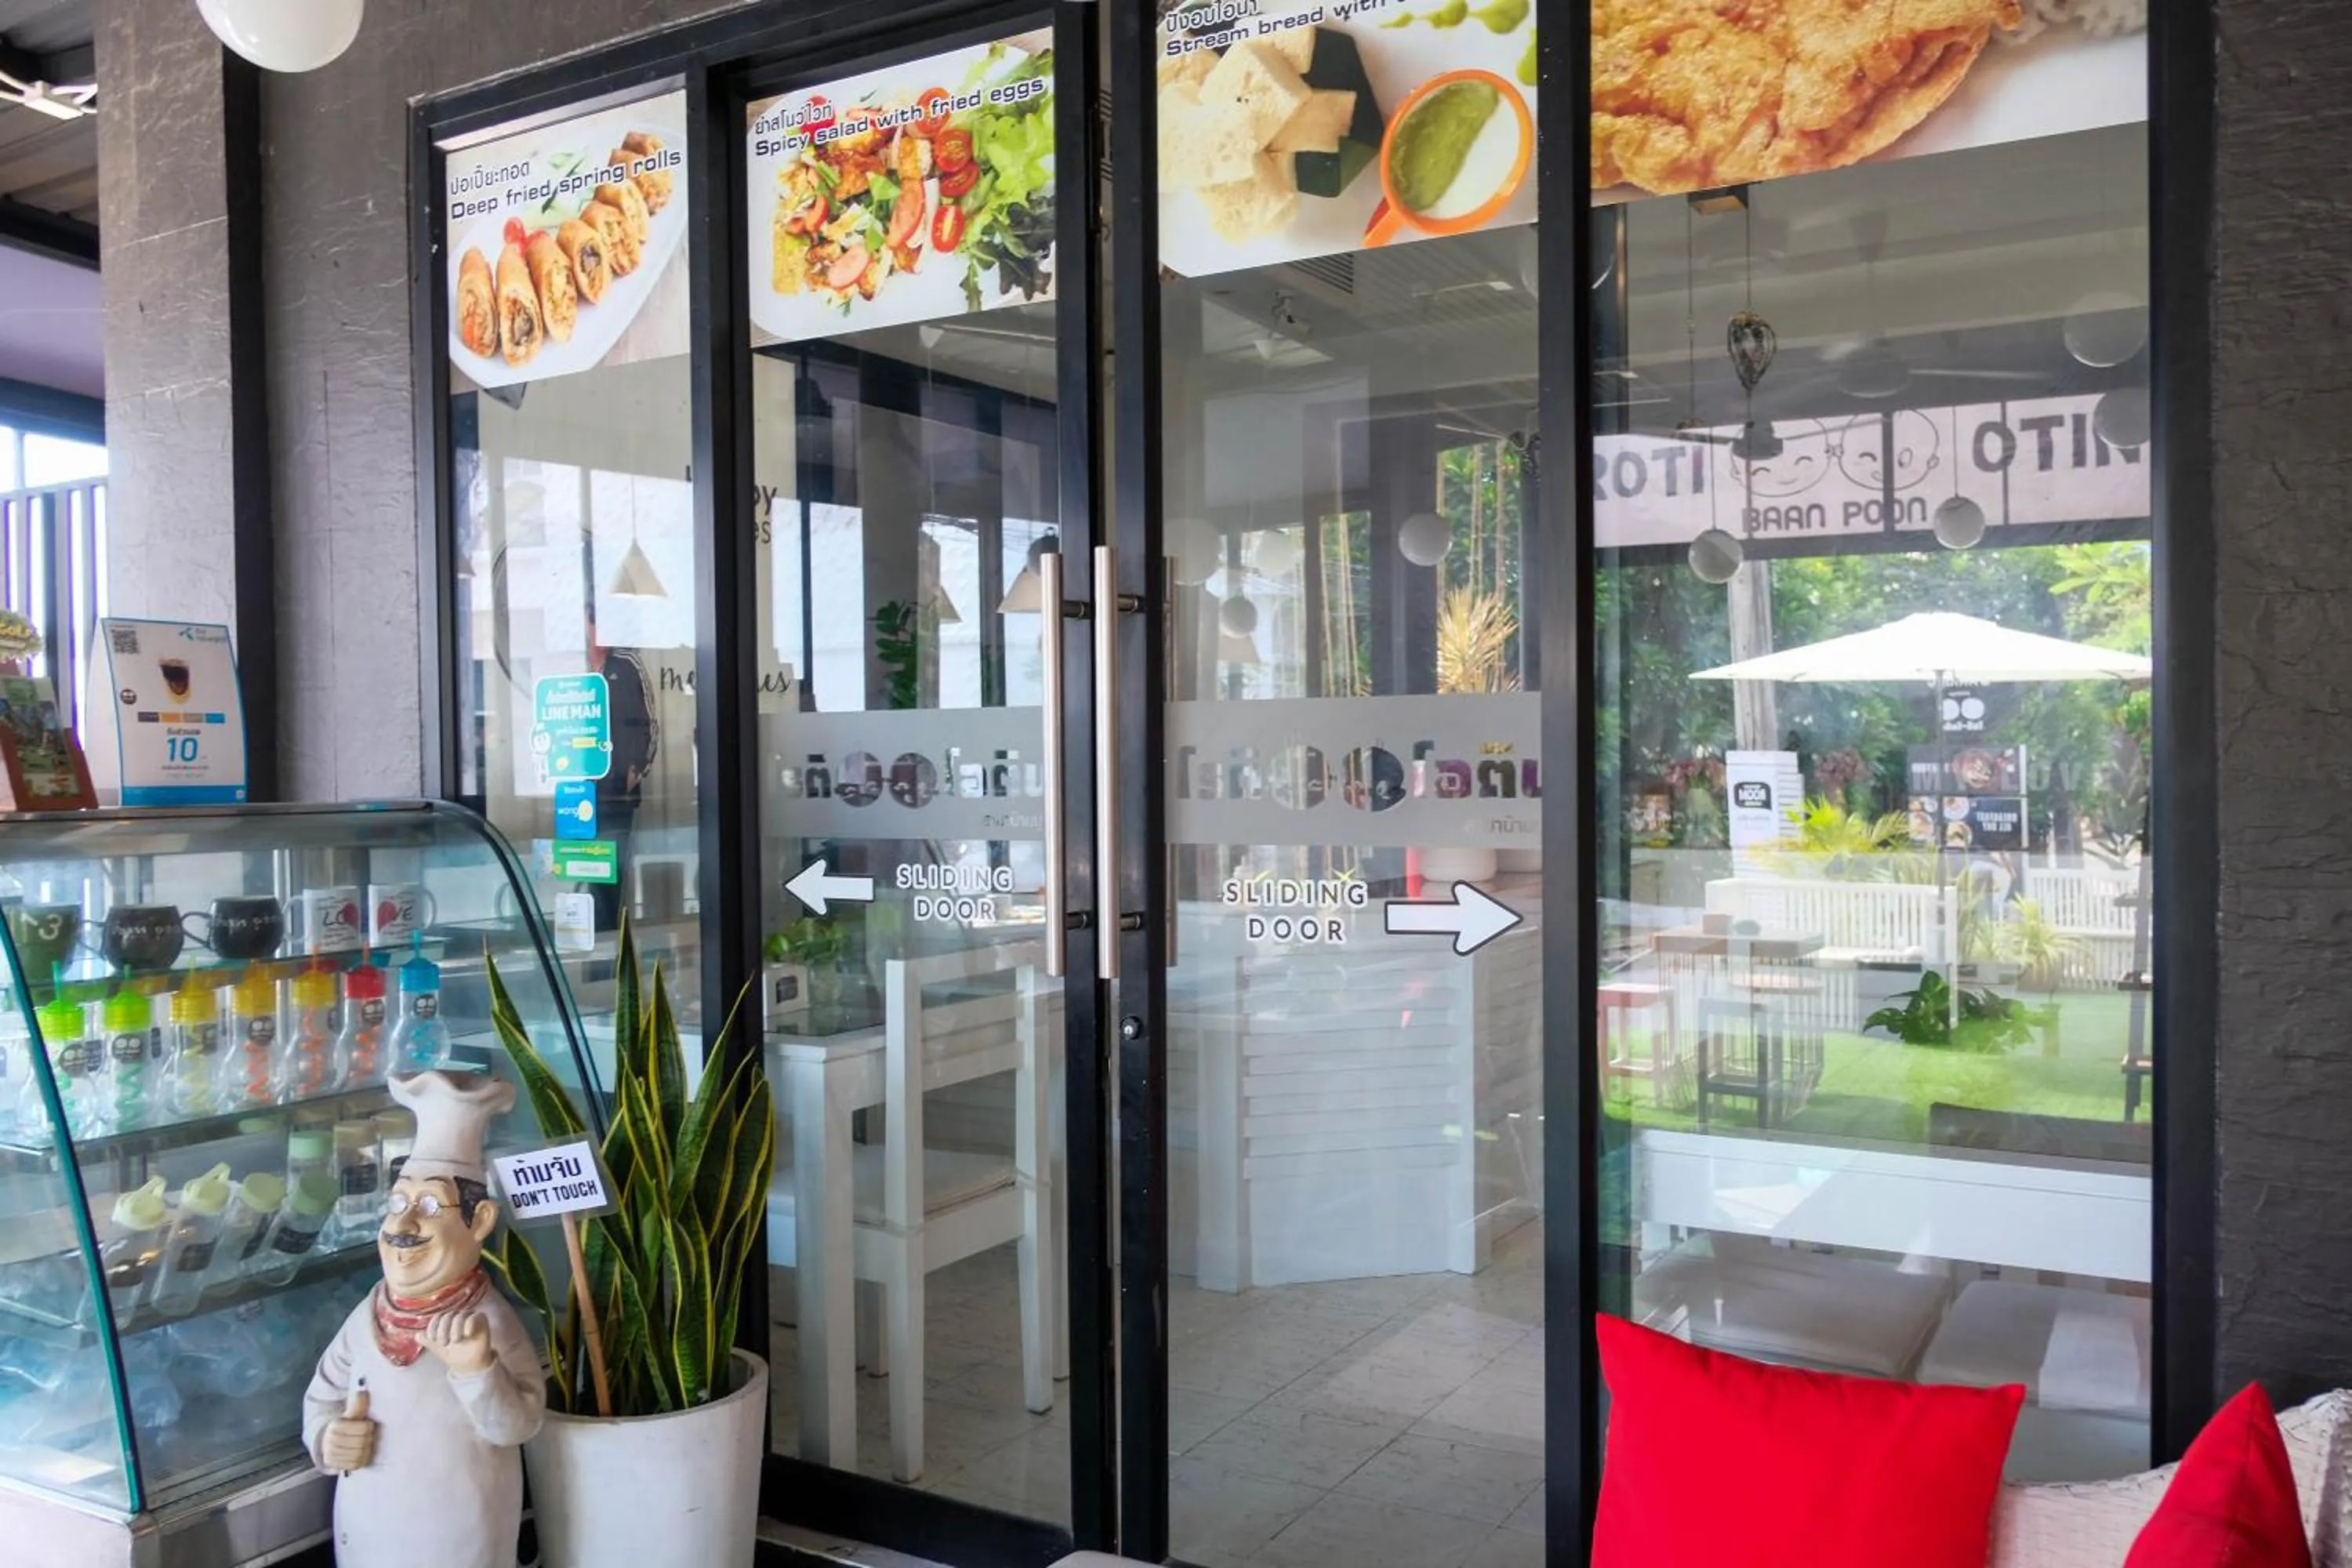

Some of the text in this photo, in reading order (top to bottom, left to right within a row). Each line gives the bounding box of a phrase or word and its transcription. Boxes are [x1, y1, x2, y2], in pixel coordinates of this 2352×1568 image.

[1166, 27, 1250, 56] Stream
[1258, 6, 1323, 35] bread
[756, 78, 1044, 156] Spicy salad with fried eggs
[451, 150, 681, 219] Deep fried spring rolls
[1742, 503, 1826, 533] BAAN
[167, 737, 198, 762] 10
[897, 864, 1013, 891] SLIDING
[1224, 879, 1367, 906] SLIDING
[914, 896, 996, 922] DOOR
[1247, 916, 1345, 942] DOOR
[513, 1156, 582, 1186] ห้ามจับ
[511, 1180, 598, 1208] DON'T TOUCH
